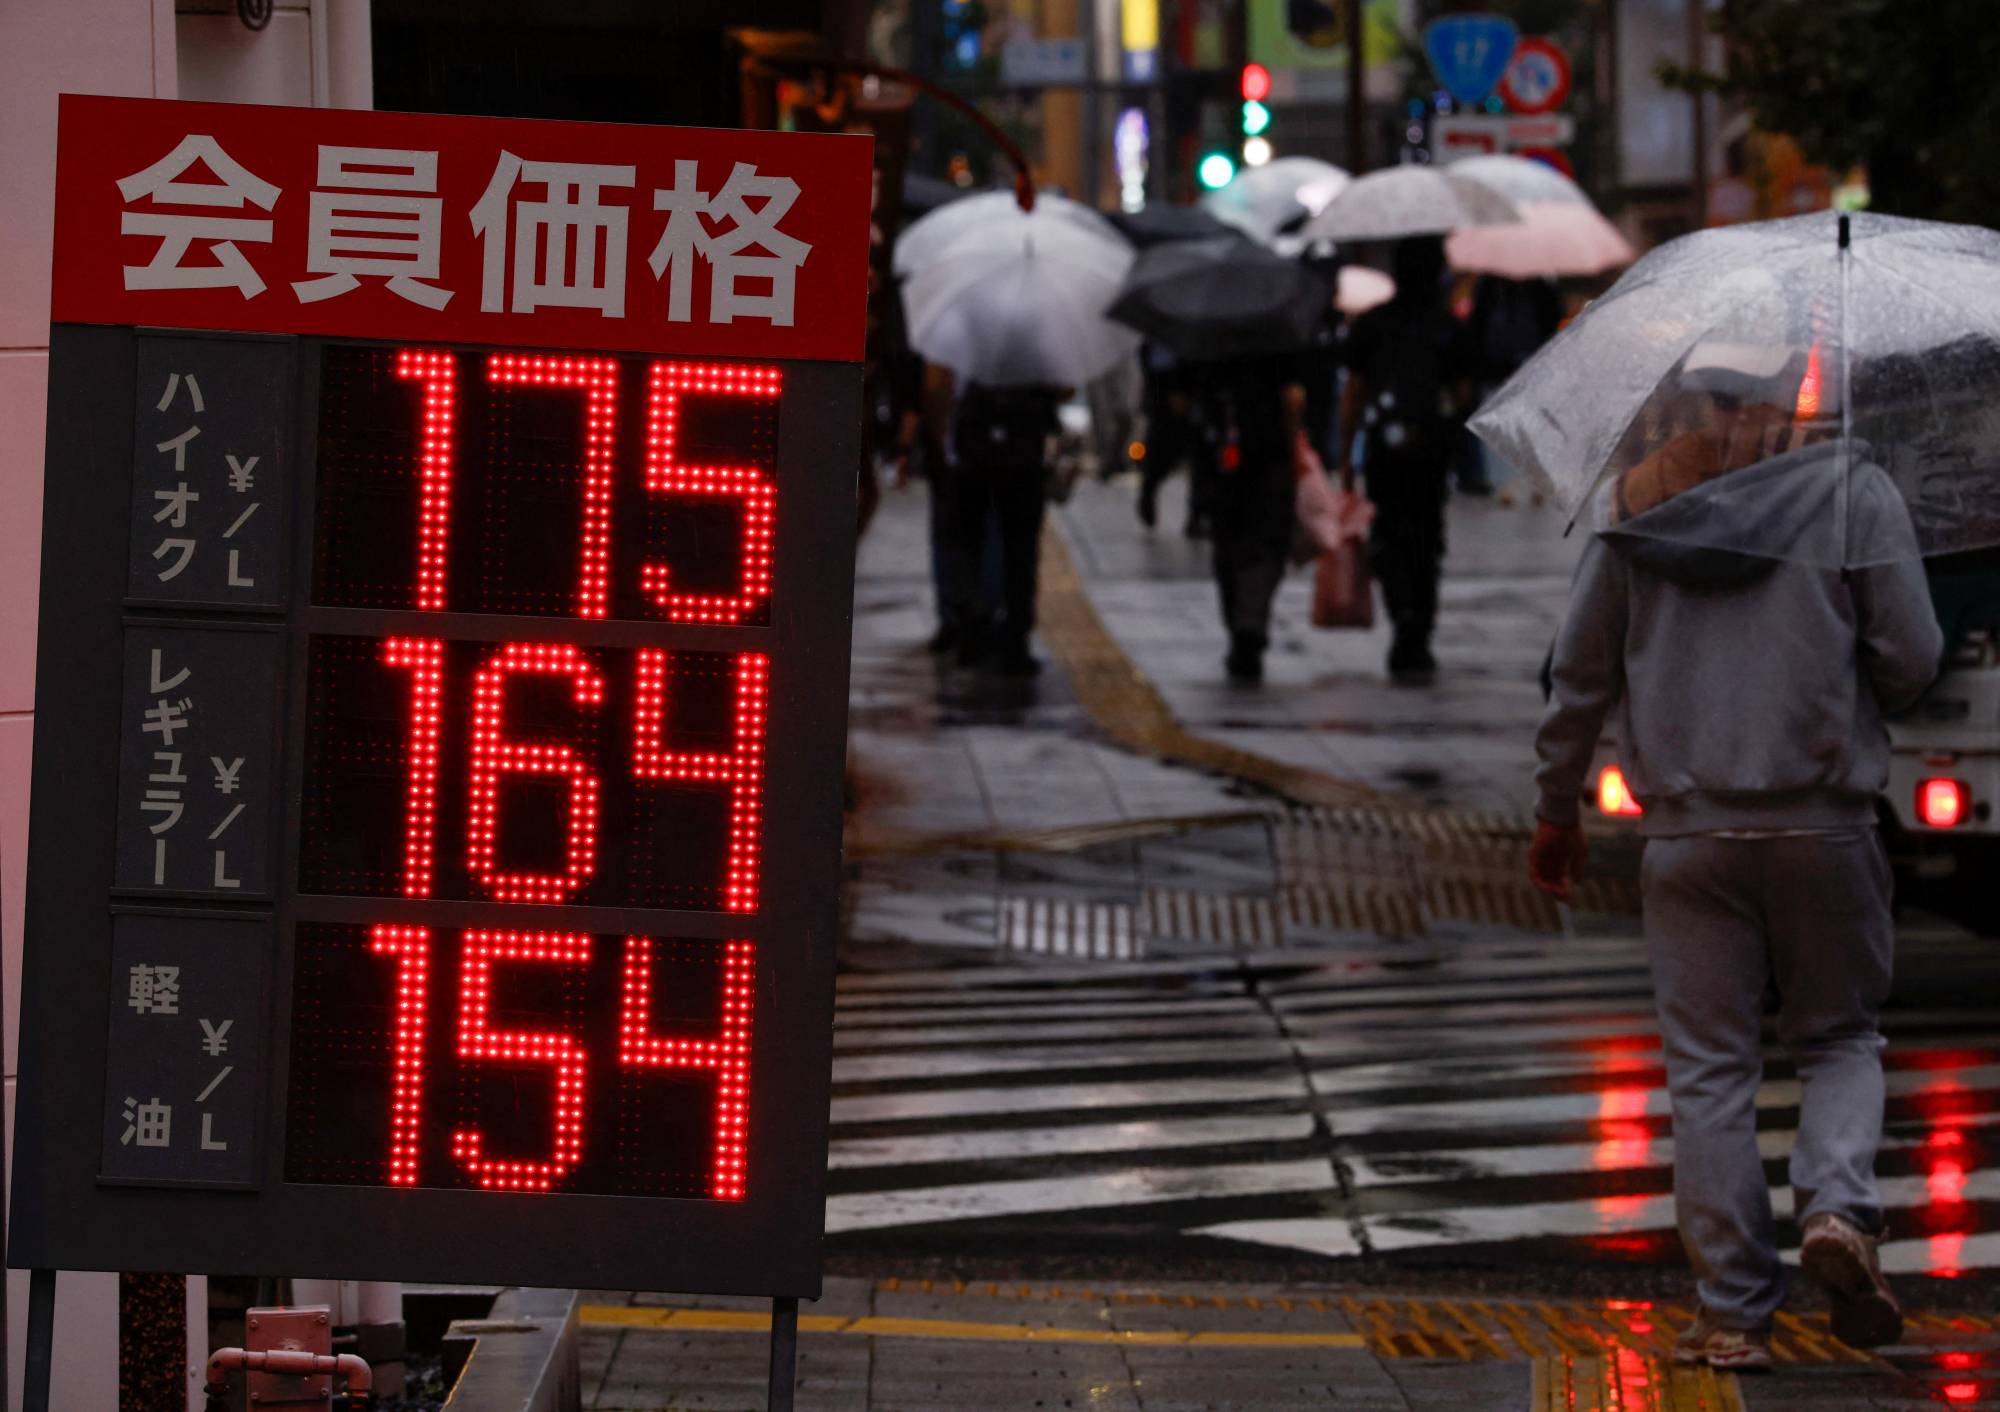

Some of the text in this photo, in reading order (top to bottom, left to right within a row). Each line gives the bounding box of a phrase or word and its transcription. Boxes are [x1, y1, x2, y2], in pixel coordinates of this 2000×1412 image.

[115, 132, 813, 328] 会員価格
[151, 372, 205, 583] ハイオク
[396, 350, 783, 624] 175
[139, 647, 192, 886] レギュラー
[383, 635, 768, 914] 164
[370, 922, 756, 1204] 154
